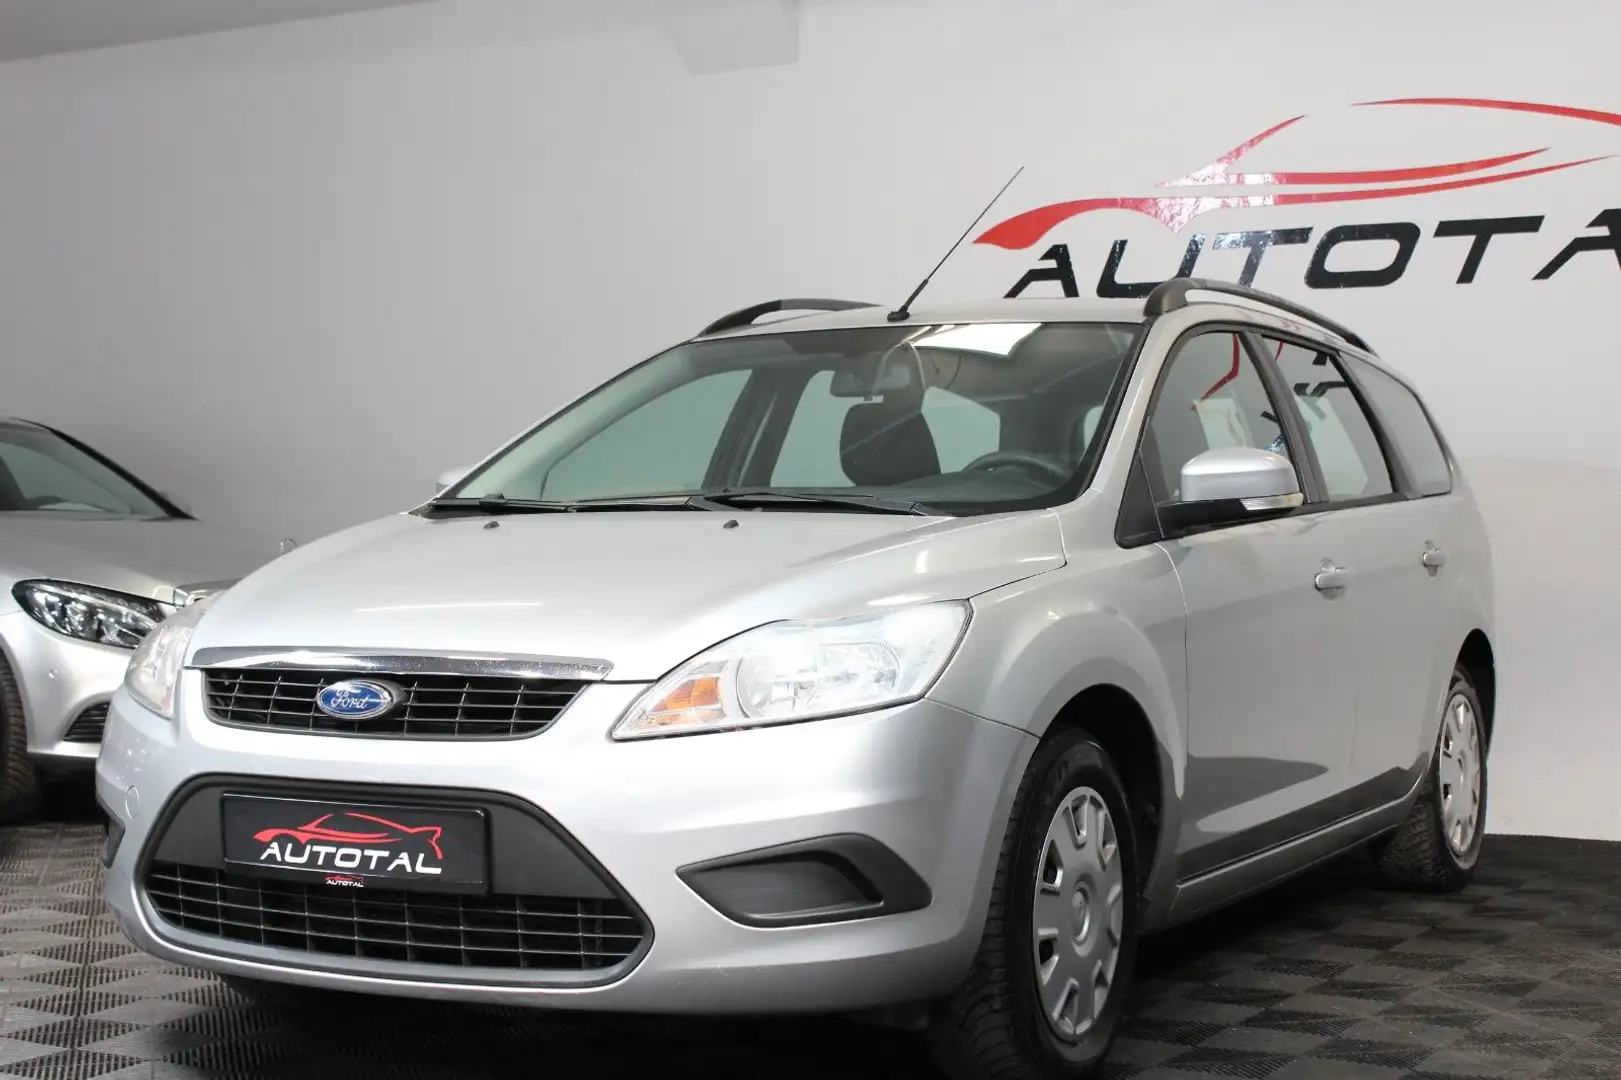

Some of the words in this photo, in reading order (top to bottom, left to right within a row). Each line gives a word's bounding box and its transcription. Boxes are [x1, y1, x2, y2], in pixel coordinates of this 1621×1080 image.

[330, 689, 369, 709] Ford
[260, 841, 442, 875] AUTOTAL
[326, 879, 364, 888] AUTOTAL
